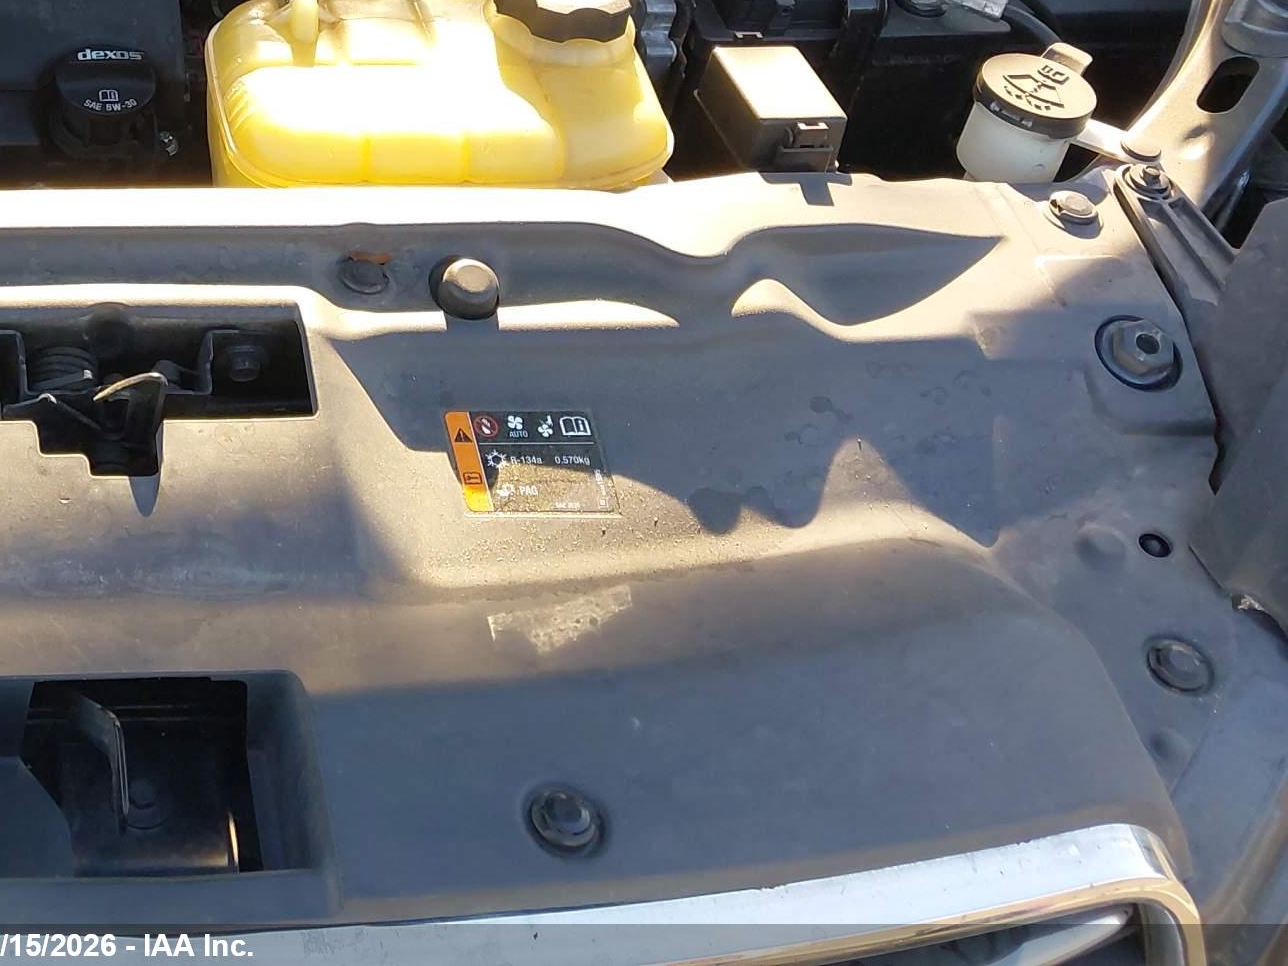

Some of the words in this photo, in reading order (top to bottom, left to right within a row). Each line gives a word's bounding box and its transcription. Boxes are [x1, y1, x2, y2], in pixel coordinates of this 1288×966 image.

[77, 48, 144, 61] dexos
[83, 99, 103, 111] SAE
[105, 98, 137, 111] 5W-30
[509, 430, 528, 438] AUTO
[510, 456, 543, 465] R-134a
[554, 456, 591, 466] 0.570kg
